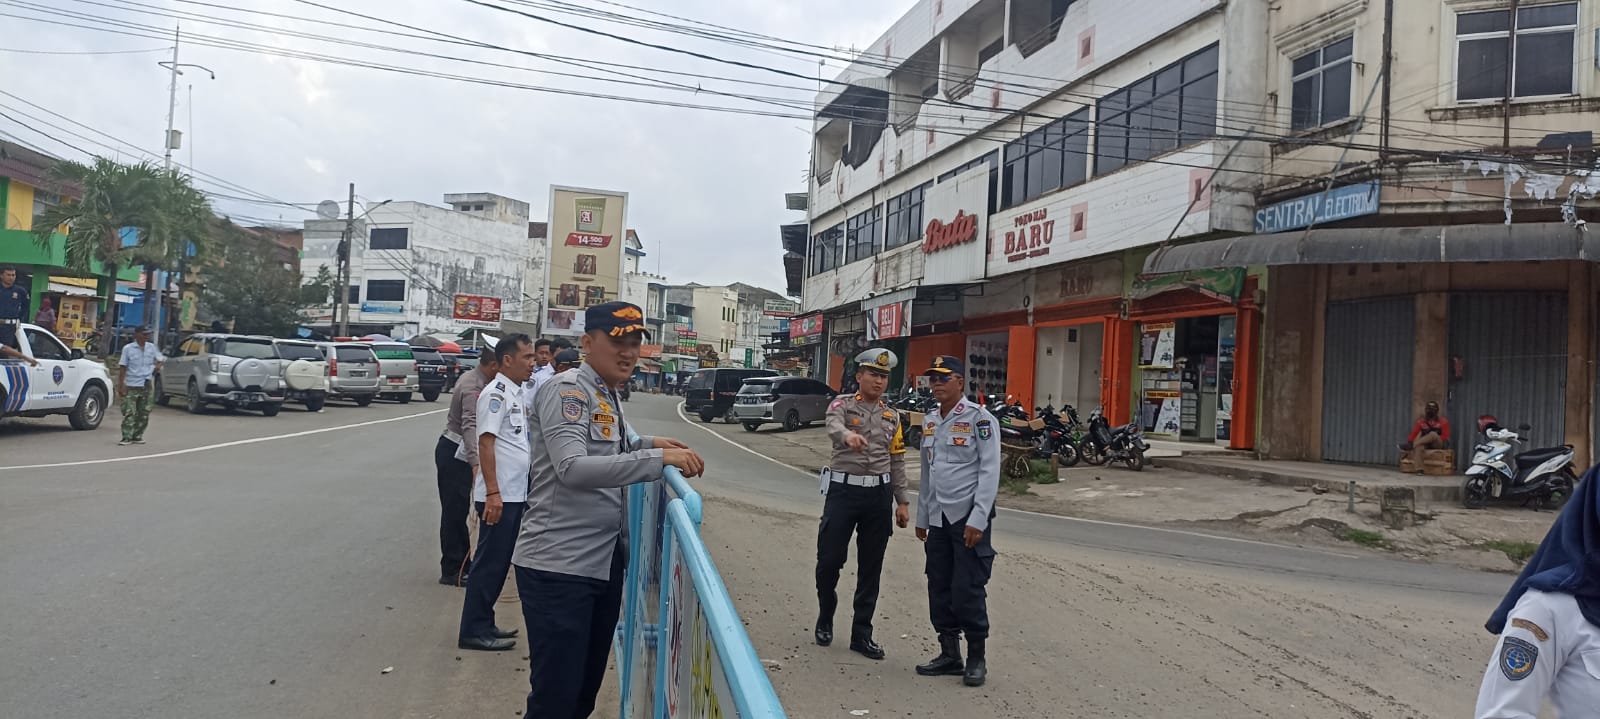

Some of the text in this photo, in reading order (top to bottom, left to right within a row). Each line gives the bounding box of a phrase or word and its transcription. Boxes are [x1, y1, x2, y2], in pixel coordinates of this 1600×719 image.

[922, 209, 977, 255] Bata
[1014, 213, 1033, 227] TOKO
[1255, 196, 1323, 233] SENTRAL
[1004, 220, 1055, 255] BARU
